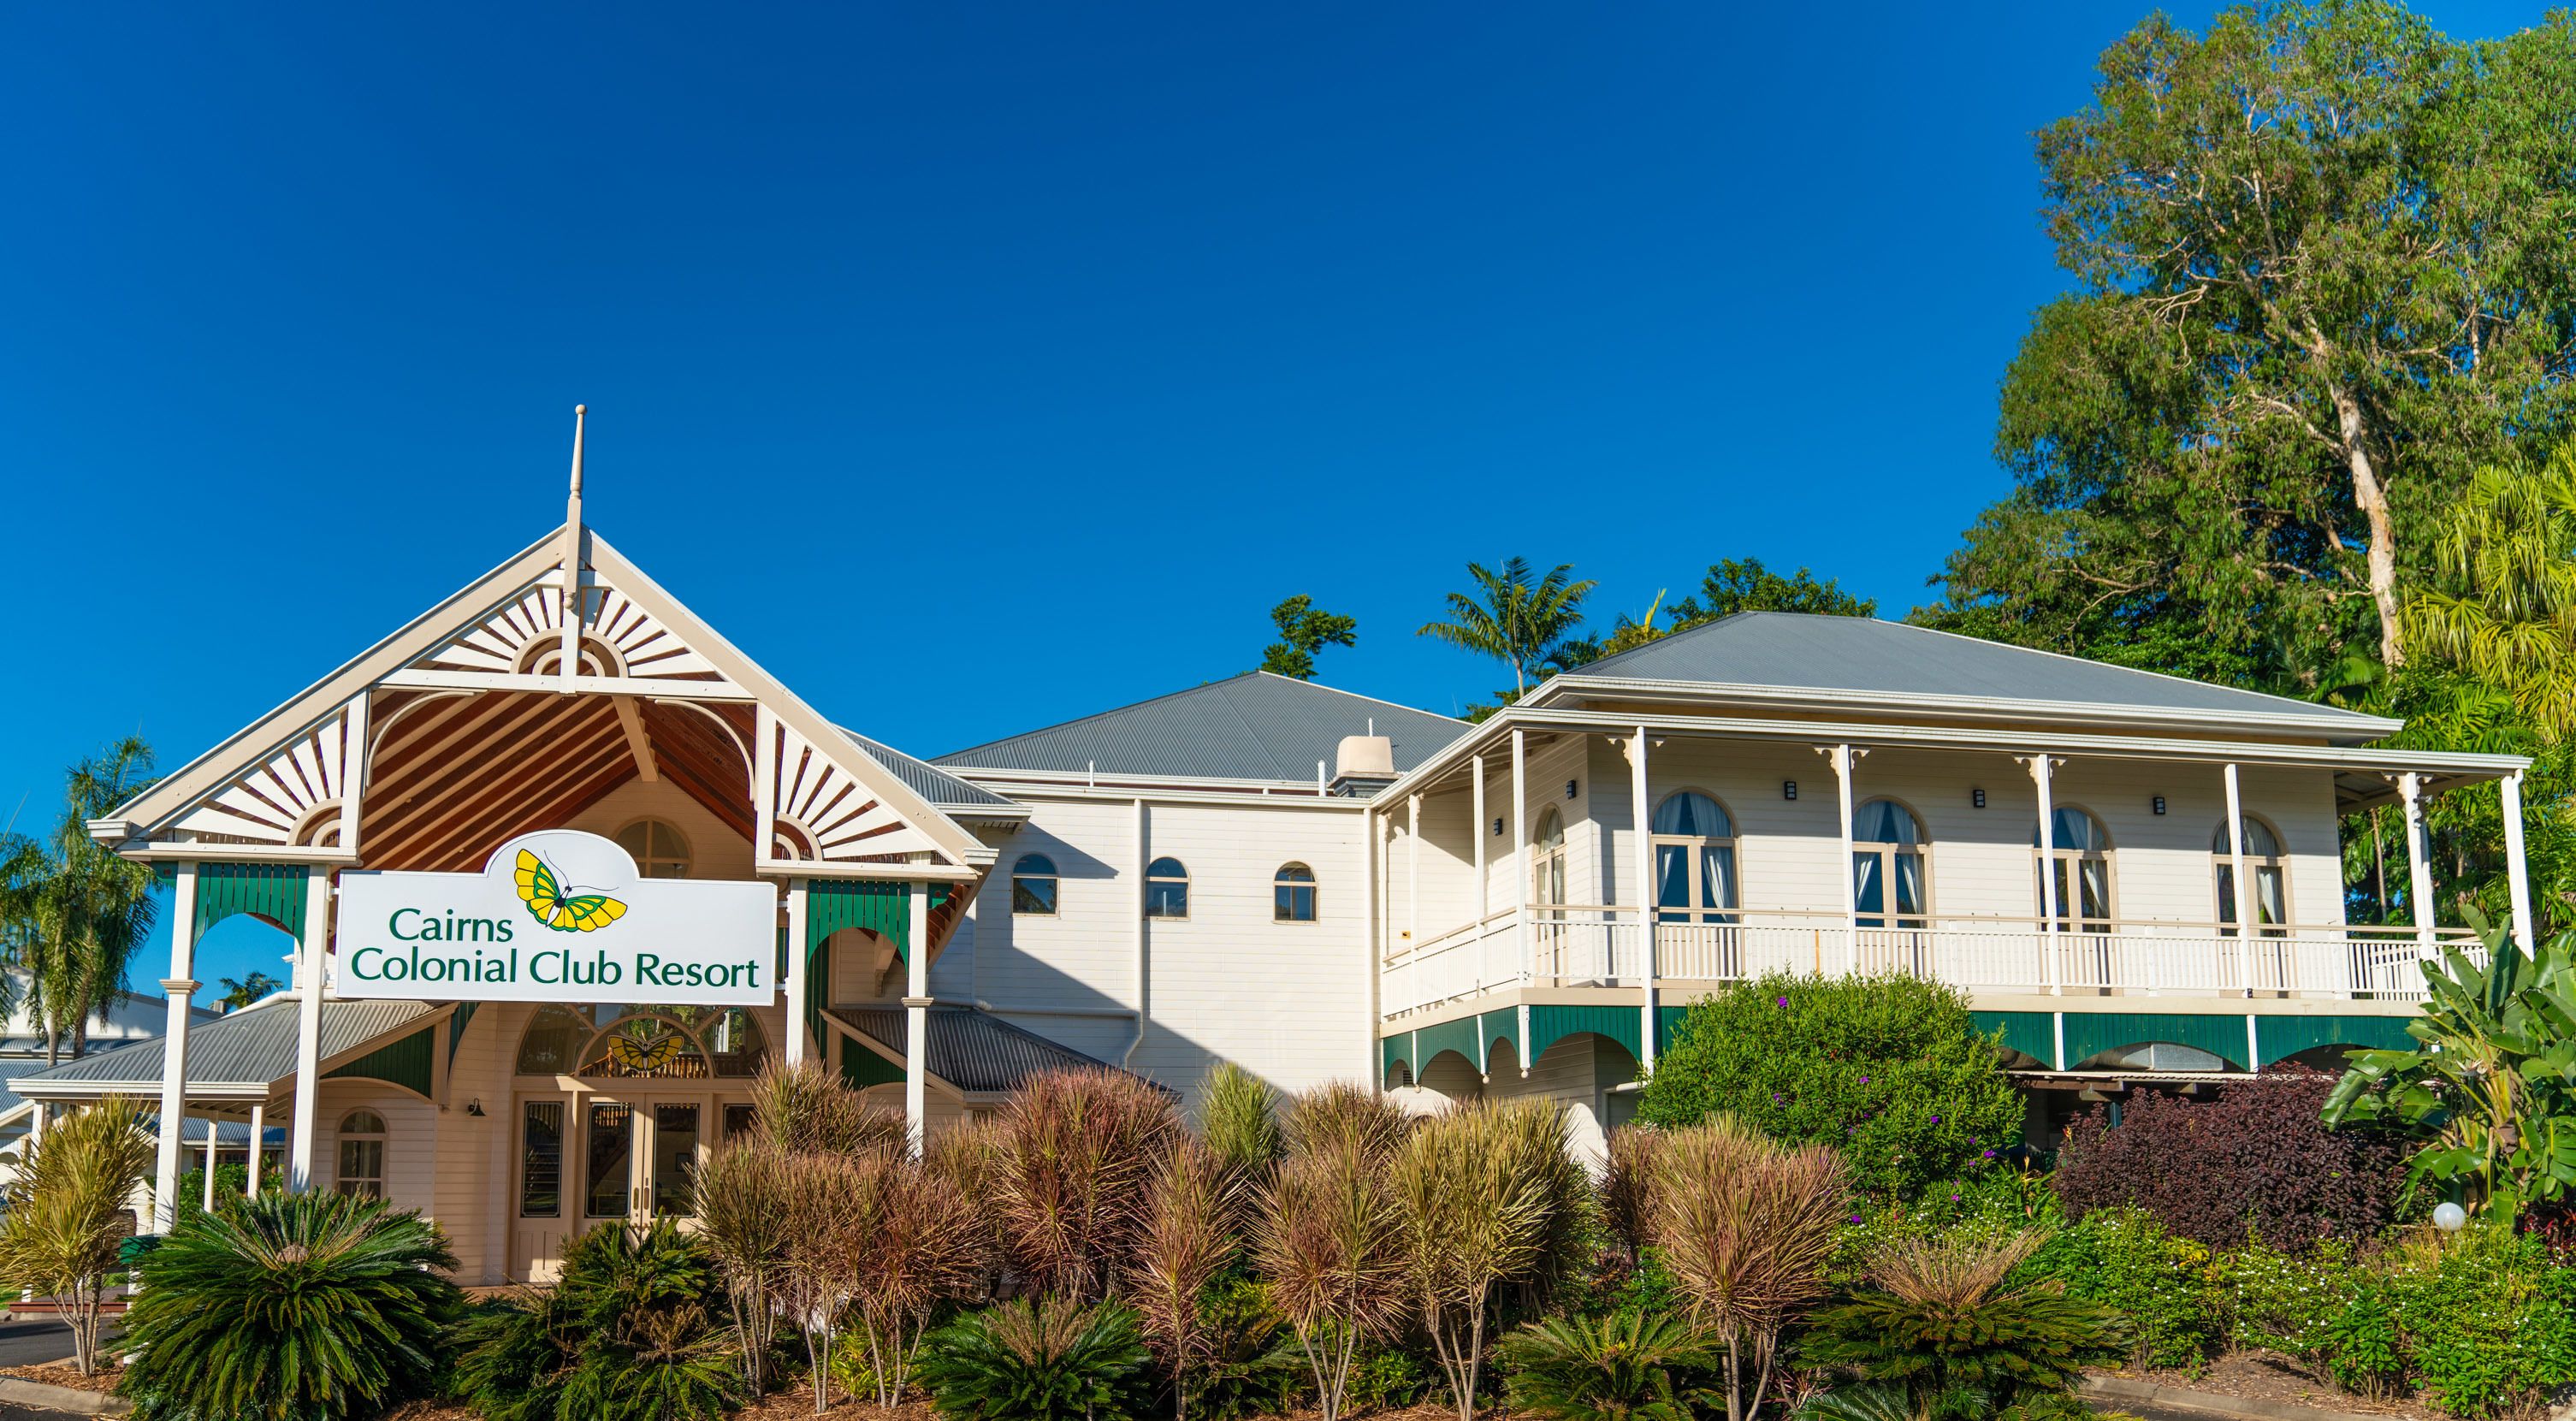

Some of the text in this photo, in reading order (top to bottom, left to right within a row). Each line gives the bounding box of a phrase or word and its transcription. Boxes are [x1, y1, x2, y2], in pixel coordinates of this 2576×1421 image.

[388, 908, 513, 943] Cairns
[351, 945, 760, 988] Colonial Club Resort
